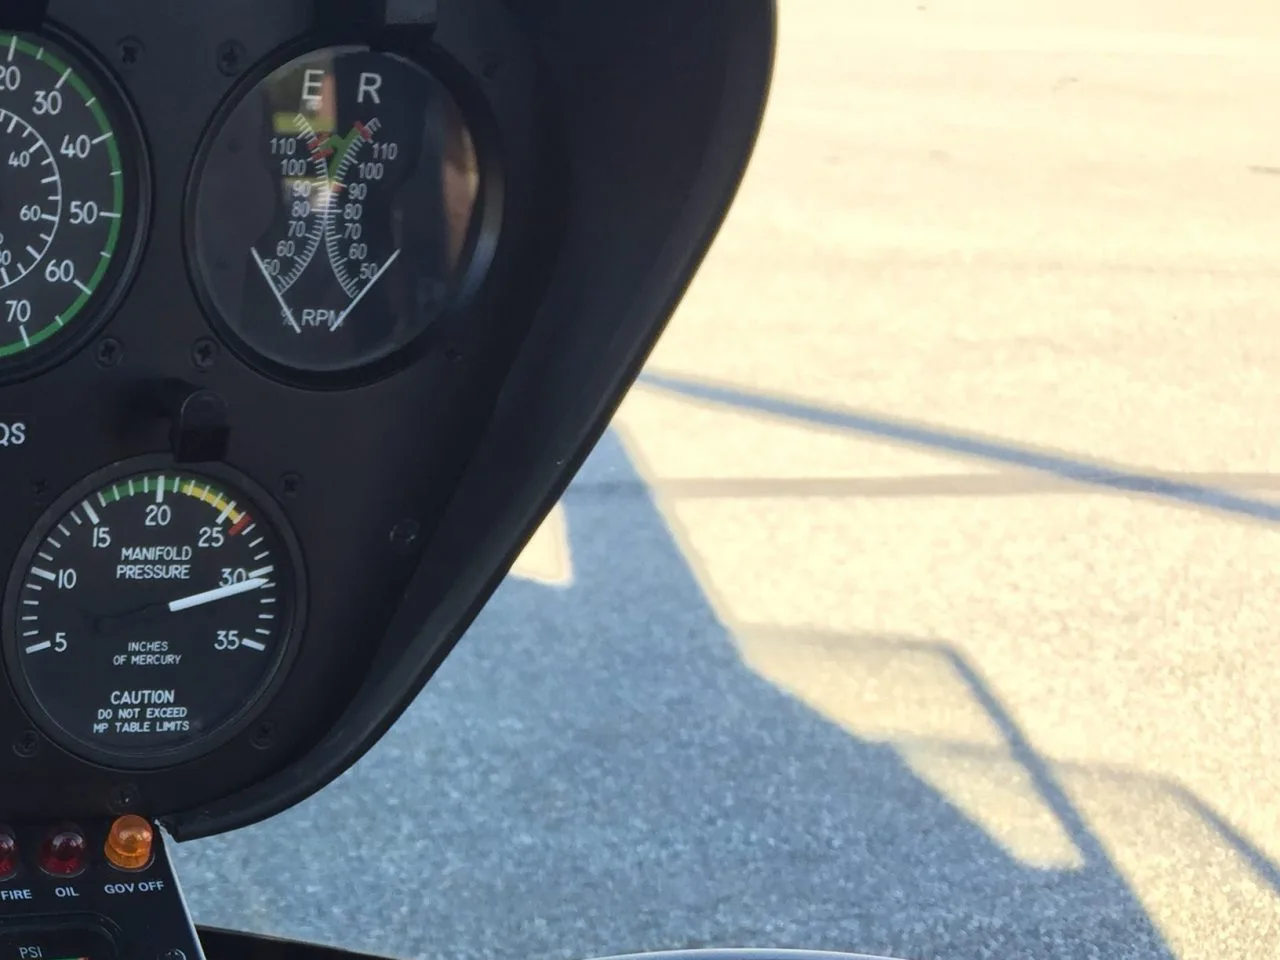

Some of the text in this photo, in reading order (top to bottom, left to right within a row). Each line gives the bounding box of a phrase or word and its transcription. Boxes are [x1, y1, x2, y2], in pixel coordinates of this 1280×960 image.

[302, 69, 325, 101] E
[357, 72, 382, 104] R
[32, 90, 62, 115] 30
[60, 135, 91, 158] 40
[8, 151, 30, 168] 40
[20, 205, 41, 221] 60
[69, 201, 98, 224] 50
[45, 259, 74, 282] 60
[5, 299, 31, 323] 70
[301, 308, 347, 327] RPM
[145, 505, 172, 526] 20
[92, 527, 112, 548] 15
[198, 527, 224, 548] 25
[120, 546, 192, 561] MANIFOLD
[58, 569, 77, 589] 10
[116, 565, 191, 580] PRESSURE
[219, 568, 248, 587] 30
[54, 632, 68, 652] 5
[128, 641, 169, 652] INCHES
[214, 630, 240, 650] 35
[113, 654, 181, 665] OF MERCURY
[110, 690, 174, 705] CAUTION
[98, 707, 187, 720] DO NOT EXCEED
[93, 721, 190, 733] MP TABLE LIMITS
[0, 889, 33, 901] FIRE
[54, 886, 79, 898] OIL
[104, 881, 165, 895] GOV OFF
[19, 946, 42, 959] PSI
